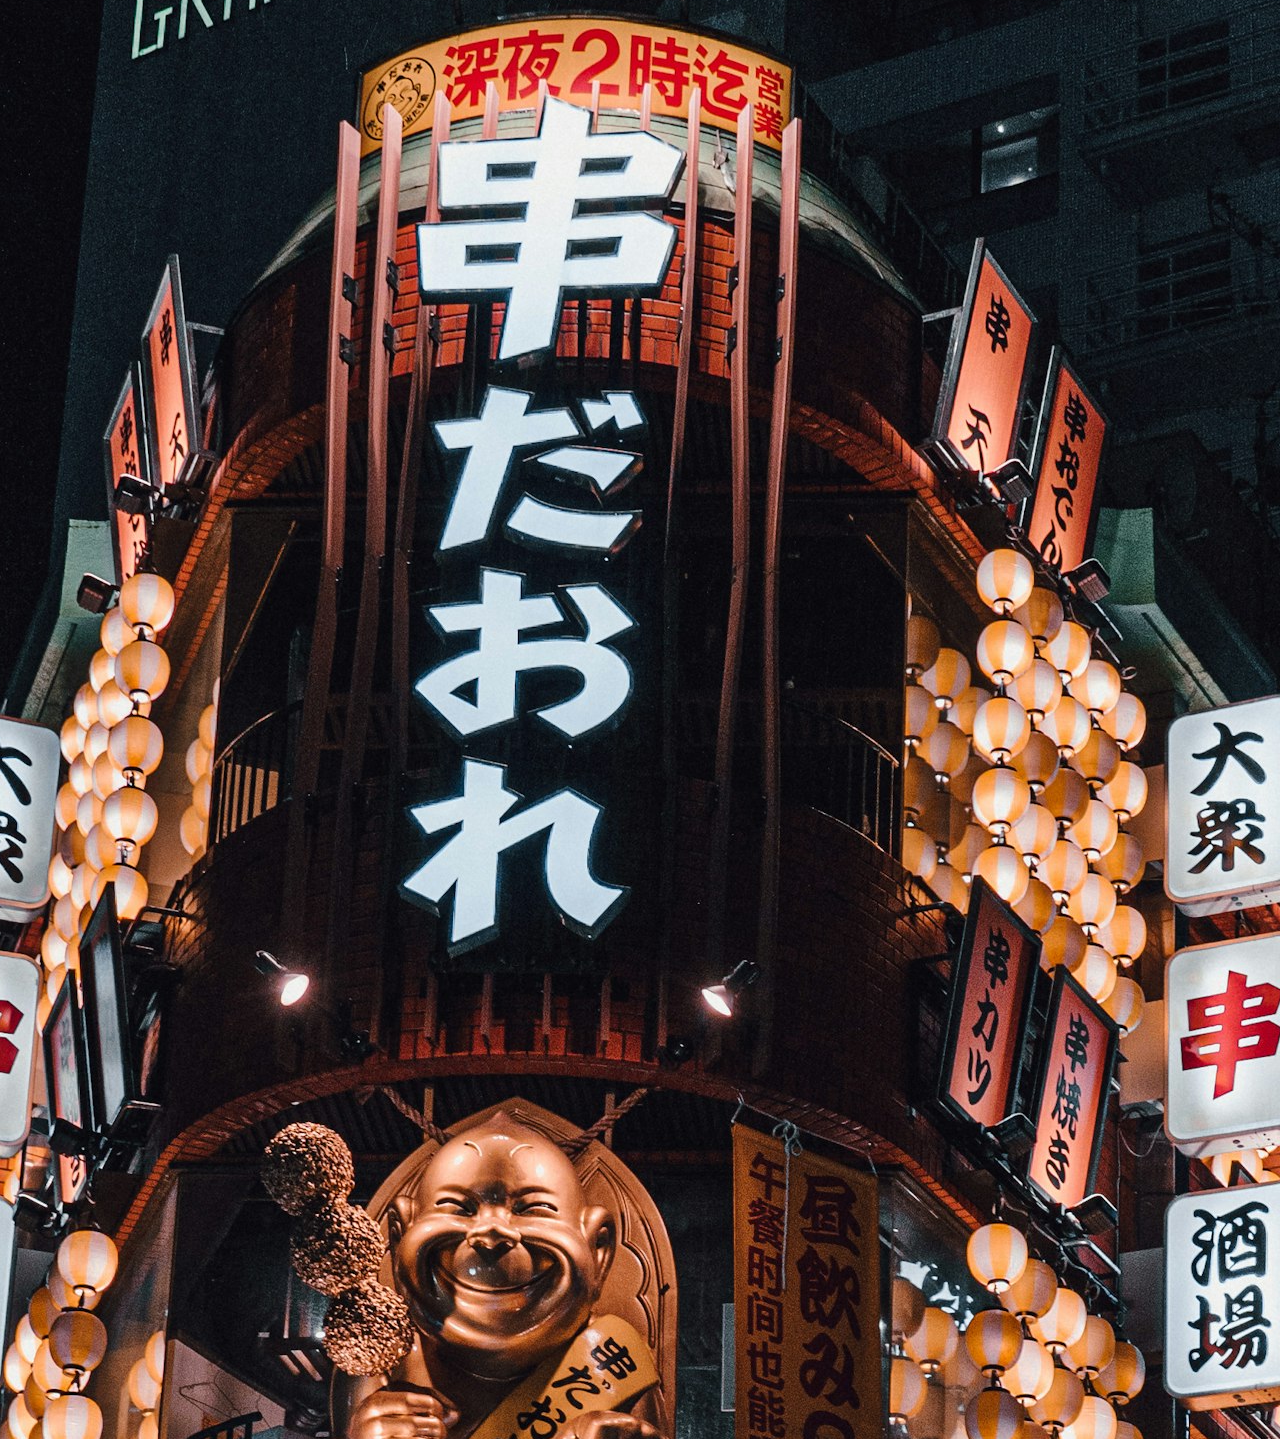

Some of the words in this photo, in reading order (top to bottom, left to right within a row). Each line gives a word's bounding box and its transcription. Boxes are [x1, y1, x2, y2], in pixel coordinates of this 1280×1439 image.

[442, 28, 750, 123] 深夜2時迄
[401, 96, 686, 956] 串だおれ
[1188, 721, 1266, 876] 大衆
[963, 925, 1012, 1106] 串カツ
[1047, 1011, 1094, 1192] 串焼き
[1187, 1198, 1273, 1375] 酒場
